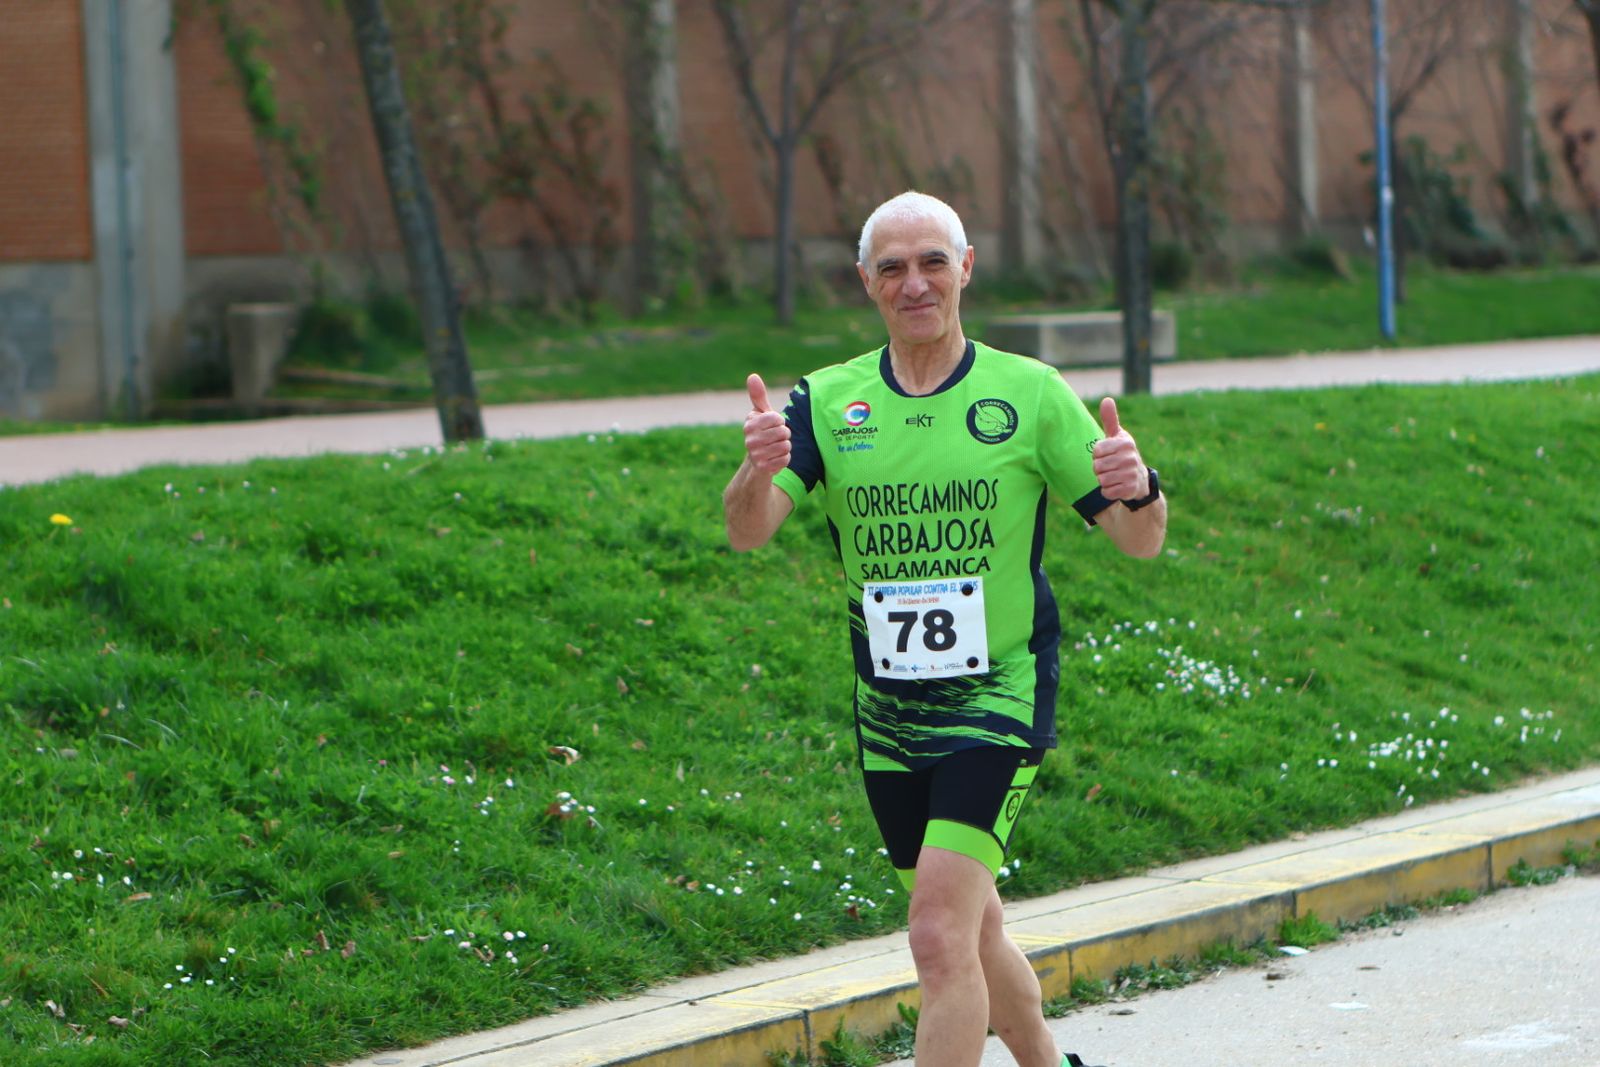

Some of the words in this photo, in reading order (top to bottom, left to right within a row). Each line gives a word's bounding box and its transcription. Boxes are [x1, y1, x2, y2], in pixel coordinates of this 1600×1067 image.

[831, 426, 878, 436] CARBAJOSA
[846, 478, 999, 518] CORRECAMINOS
[854, 517, 995, 557] CARBAJOSA
[861, 556, 991, 580] SALAMANCA
[898, 584, 922, 596] POPULAR
[924, 582, 948, 594] CONTRA
[950, 582, 957, 592] EL
[888, 608, 957, 653] 78
